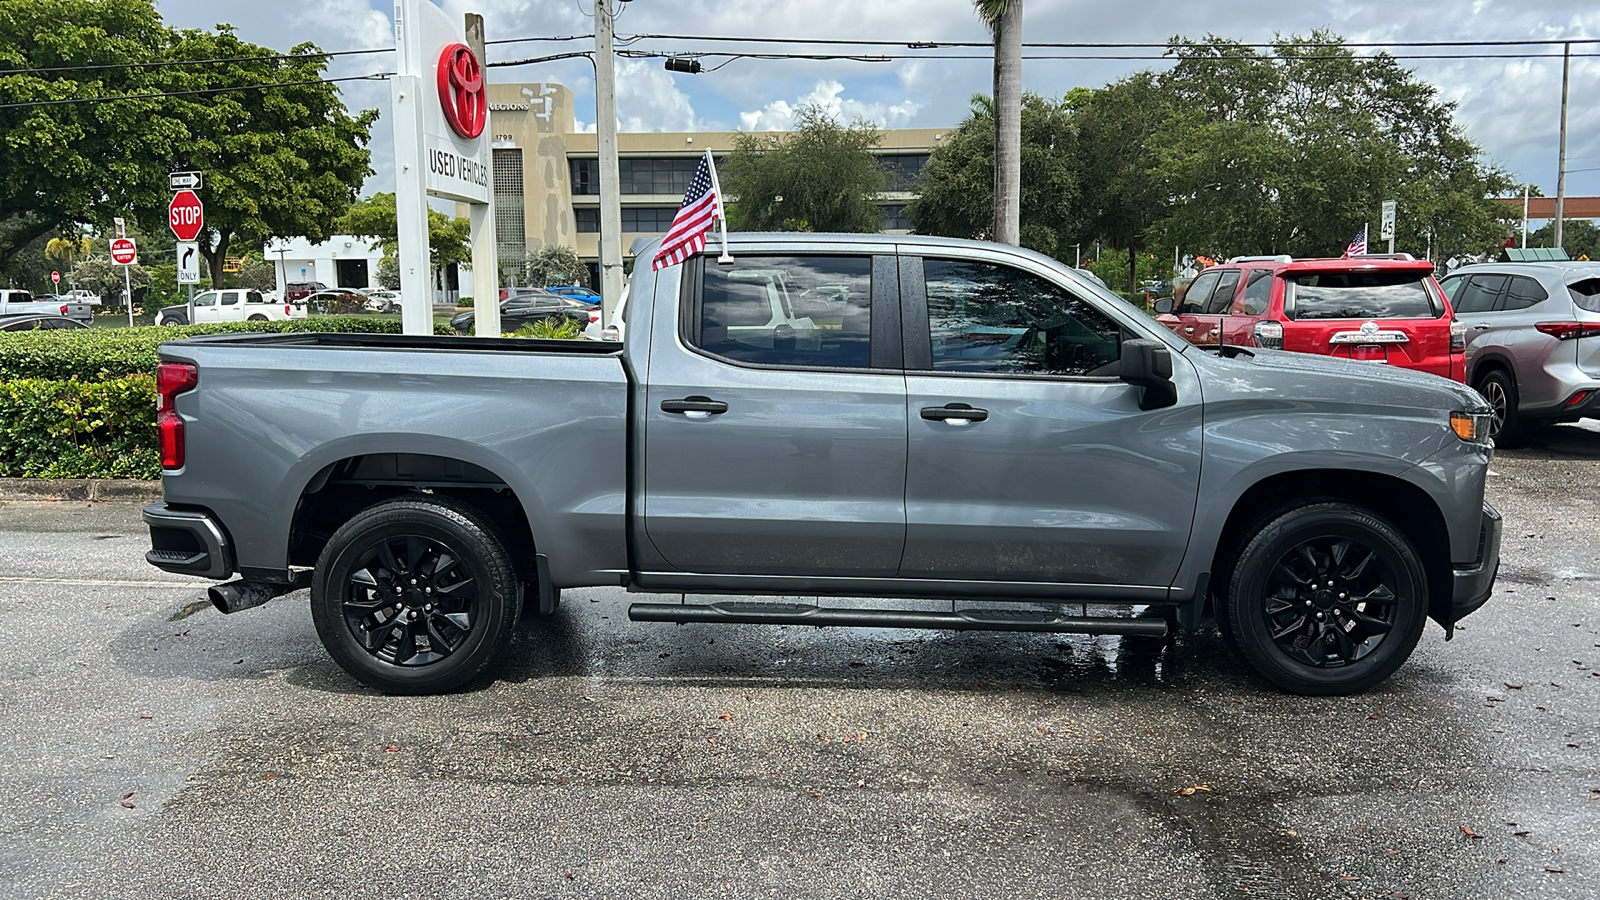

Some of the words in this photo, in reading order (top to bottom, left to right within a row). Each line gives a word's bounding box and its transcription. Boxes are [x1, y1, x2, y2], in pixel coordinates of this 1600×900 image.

[488, 102, 529, 111] REGIONS
[429, 148, 456, 178] USED
[456, 156, 488, 188] VEHICLES
[172, 206, 201, 225] STOP
[1382, 221, 1393, 236] 45
[180, 272, 197, 280] ONLY
